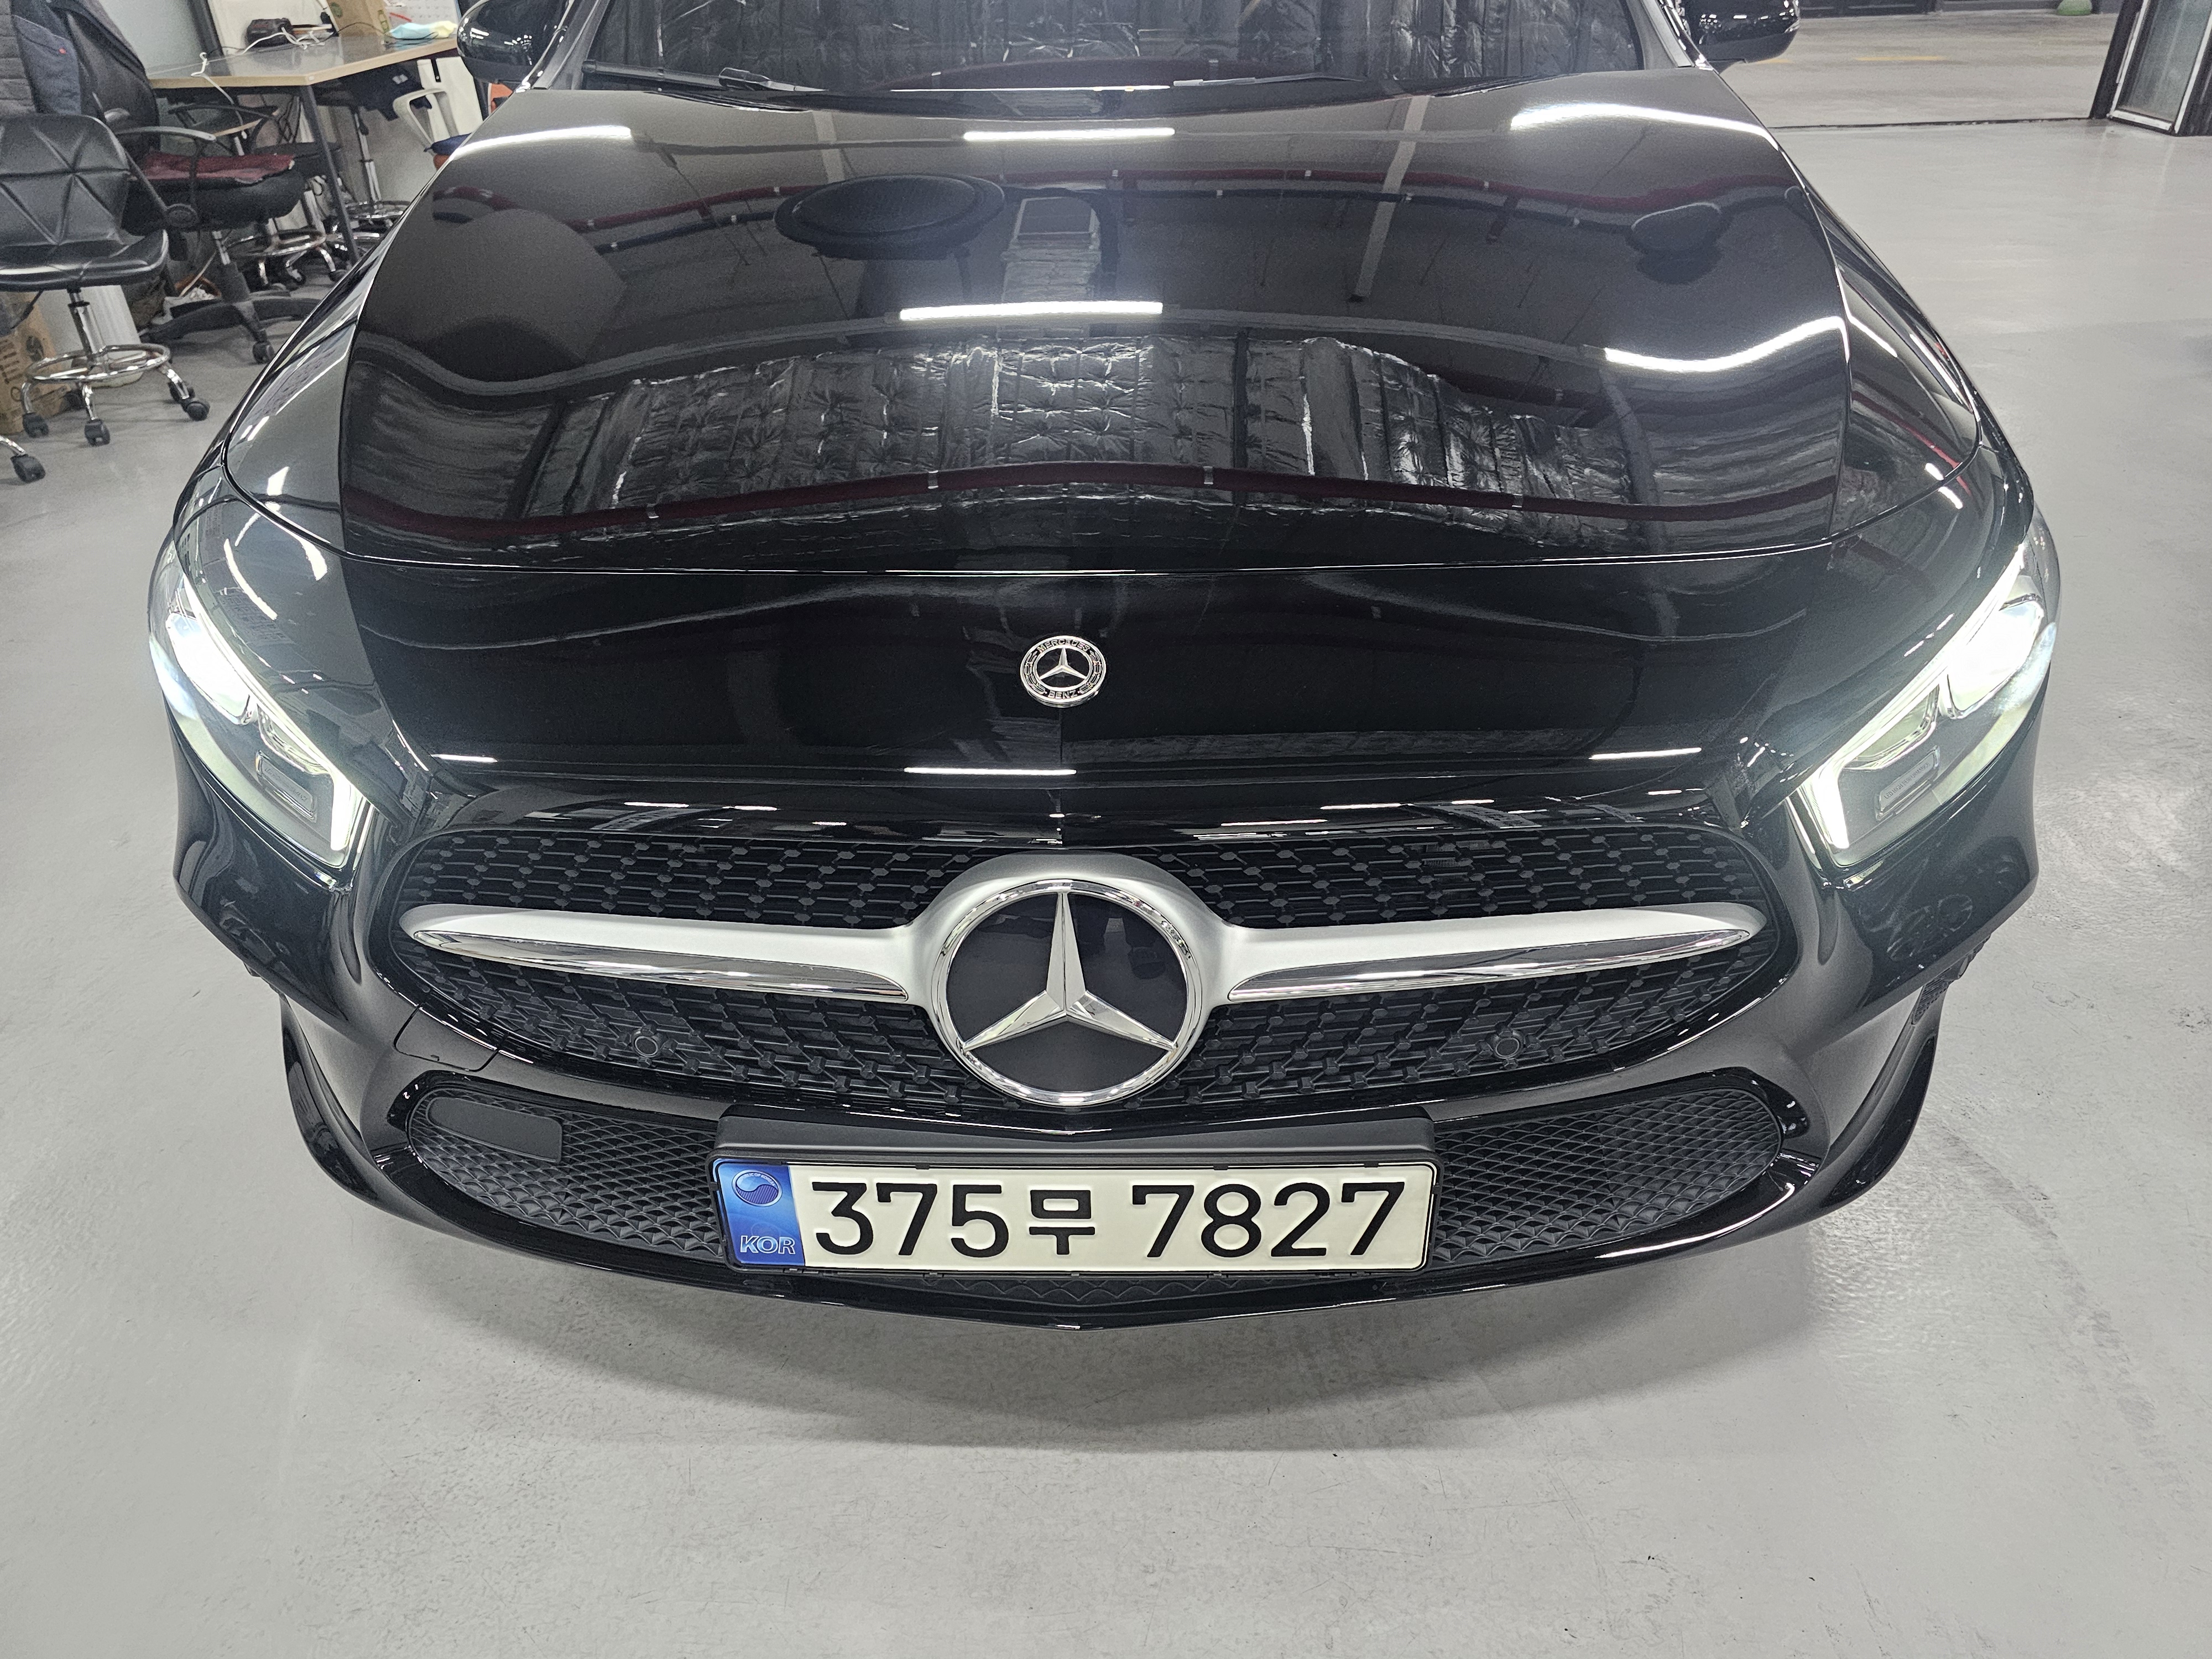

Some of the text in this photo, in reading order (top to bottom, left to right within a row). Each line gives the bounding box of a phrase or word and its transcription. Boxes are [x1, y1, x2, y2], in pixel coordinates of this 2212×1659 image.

[1037, 638, 1091, 653] MERCEDES
[1047, 690, 1078, 700] BENZ
[812, 1181, 1405, 1258] 375무 7827
[740, 1235, 796, 1255] KOR
